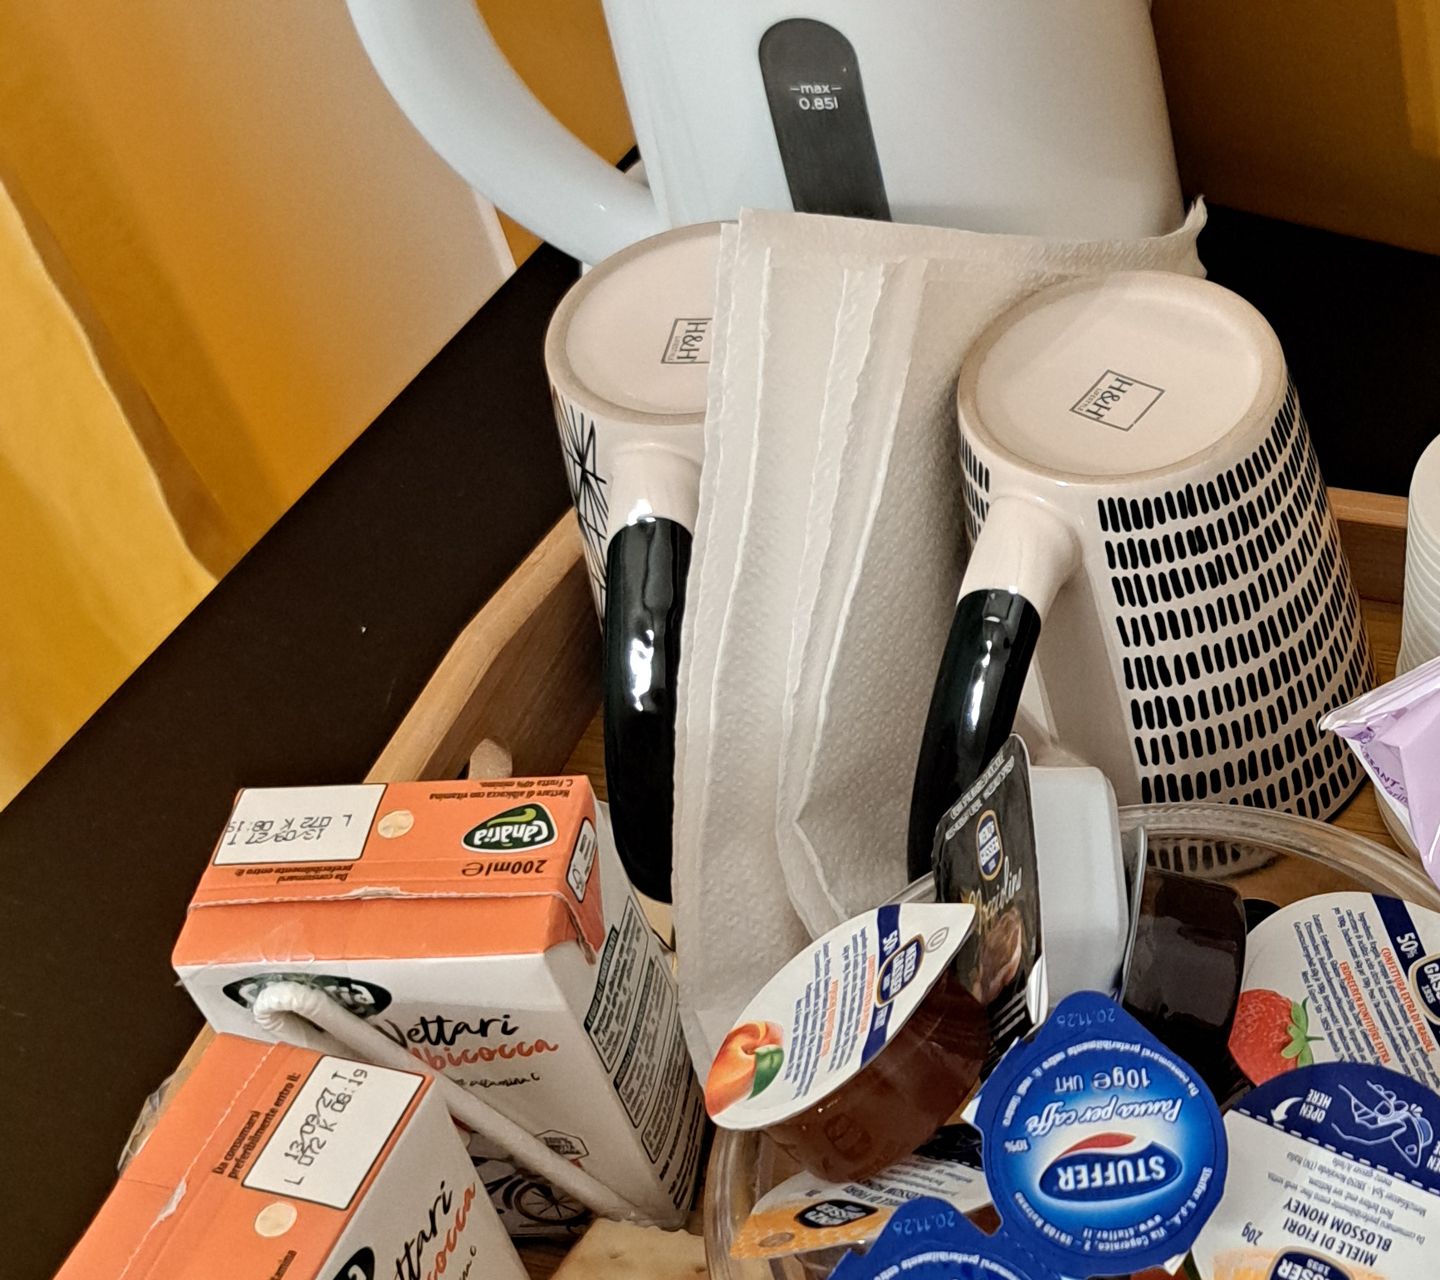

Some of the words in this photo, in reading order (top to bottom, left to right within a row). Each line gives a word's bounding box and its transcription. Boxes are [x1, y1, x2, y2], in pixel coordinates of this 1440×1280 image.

[800, 84, 831, 94] max
[677, 322, 708, 360] H&H
[1085, 377, 1134, 418] H&H
[474, 816, 550, 847] Canaria
[1054, 1076, 1084, 1093] UHT
[1306, 1088, 1333, 1108] HERE
[298, 1136, 327, 1166] 072
[319, 1119, 339, 1132] K
[330, 1068, 369, 1113] 08:19
[1076, 1095, 1118, 1123] per
[1116, 1097, 1183, 1122] Panna
[1299, 1104, 1327, 1123] OPEN
[1004, 1138, 1030, 1153] 10%
[1057, 1155, 1167, 1192] STUFFER
[1282, 1196, 1331, 1227] HONEY
[1240, 1221, 1264, 1247] 20g
[1281, 1217, 1321, 1244] FIORI
[1321, 1234, 1336, 1251] DI
[1330, 1217, 1394, 1252] BLOSSOM
[1335, 1240, 1379, 1267] MIELE
